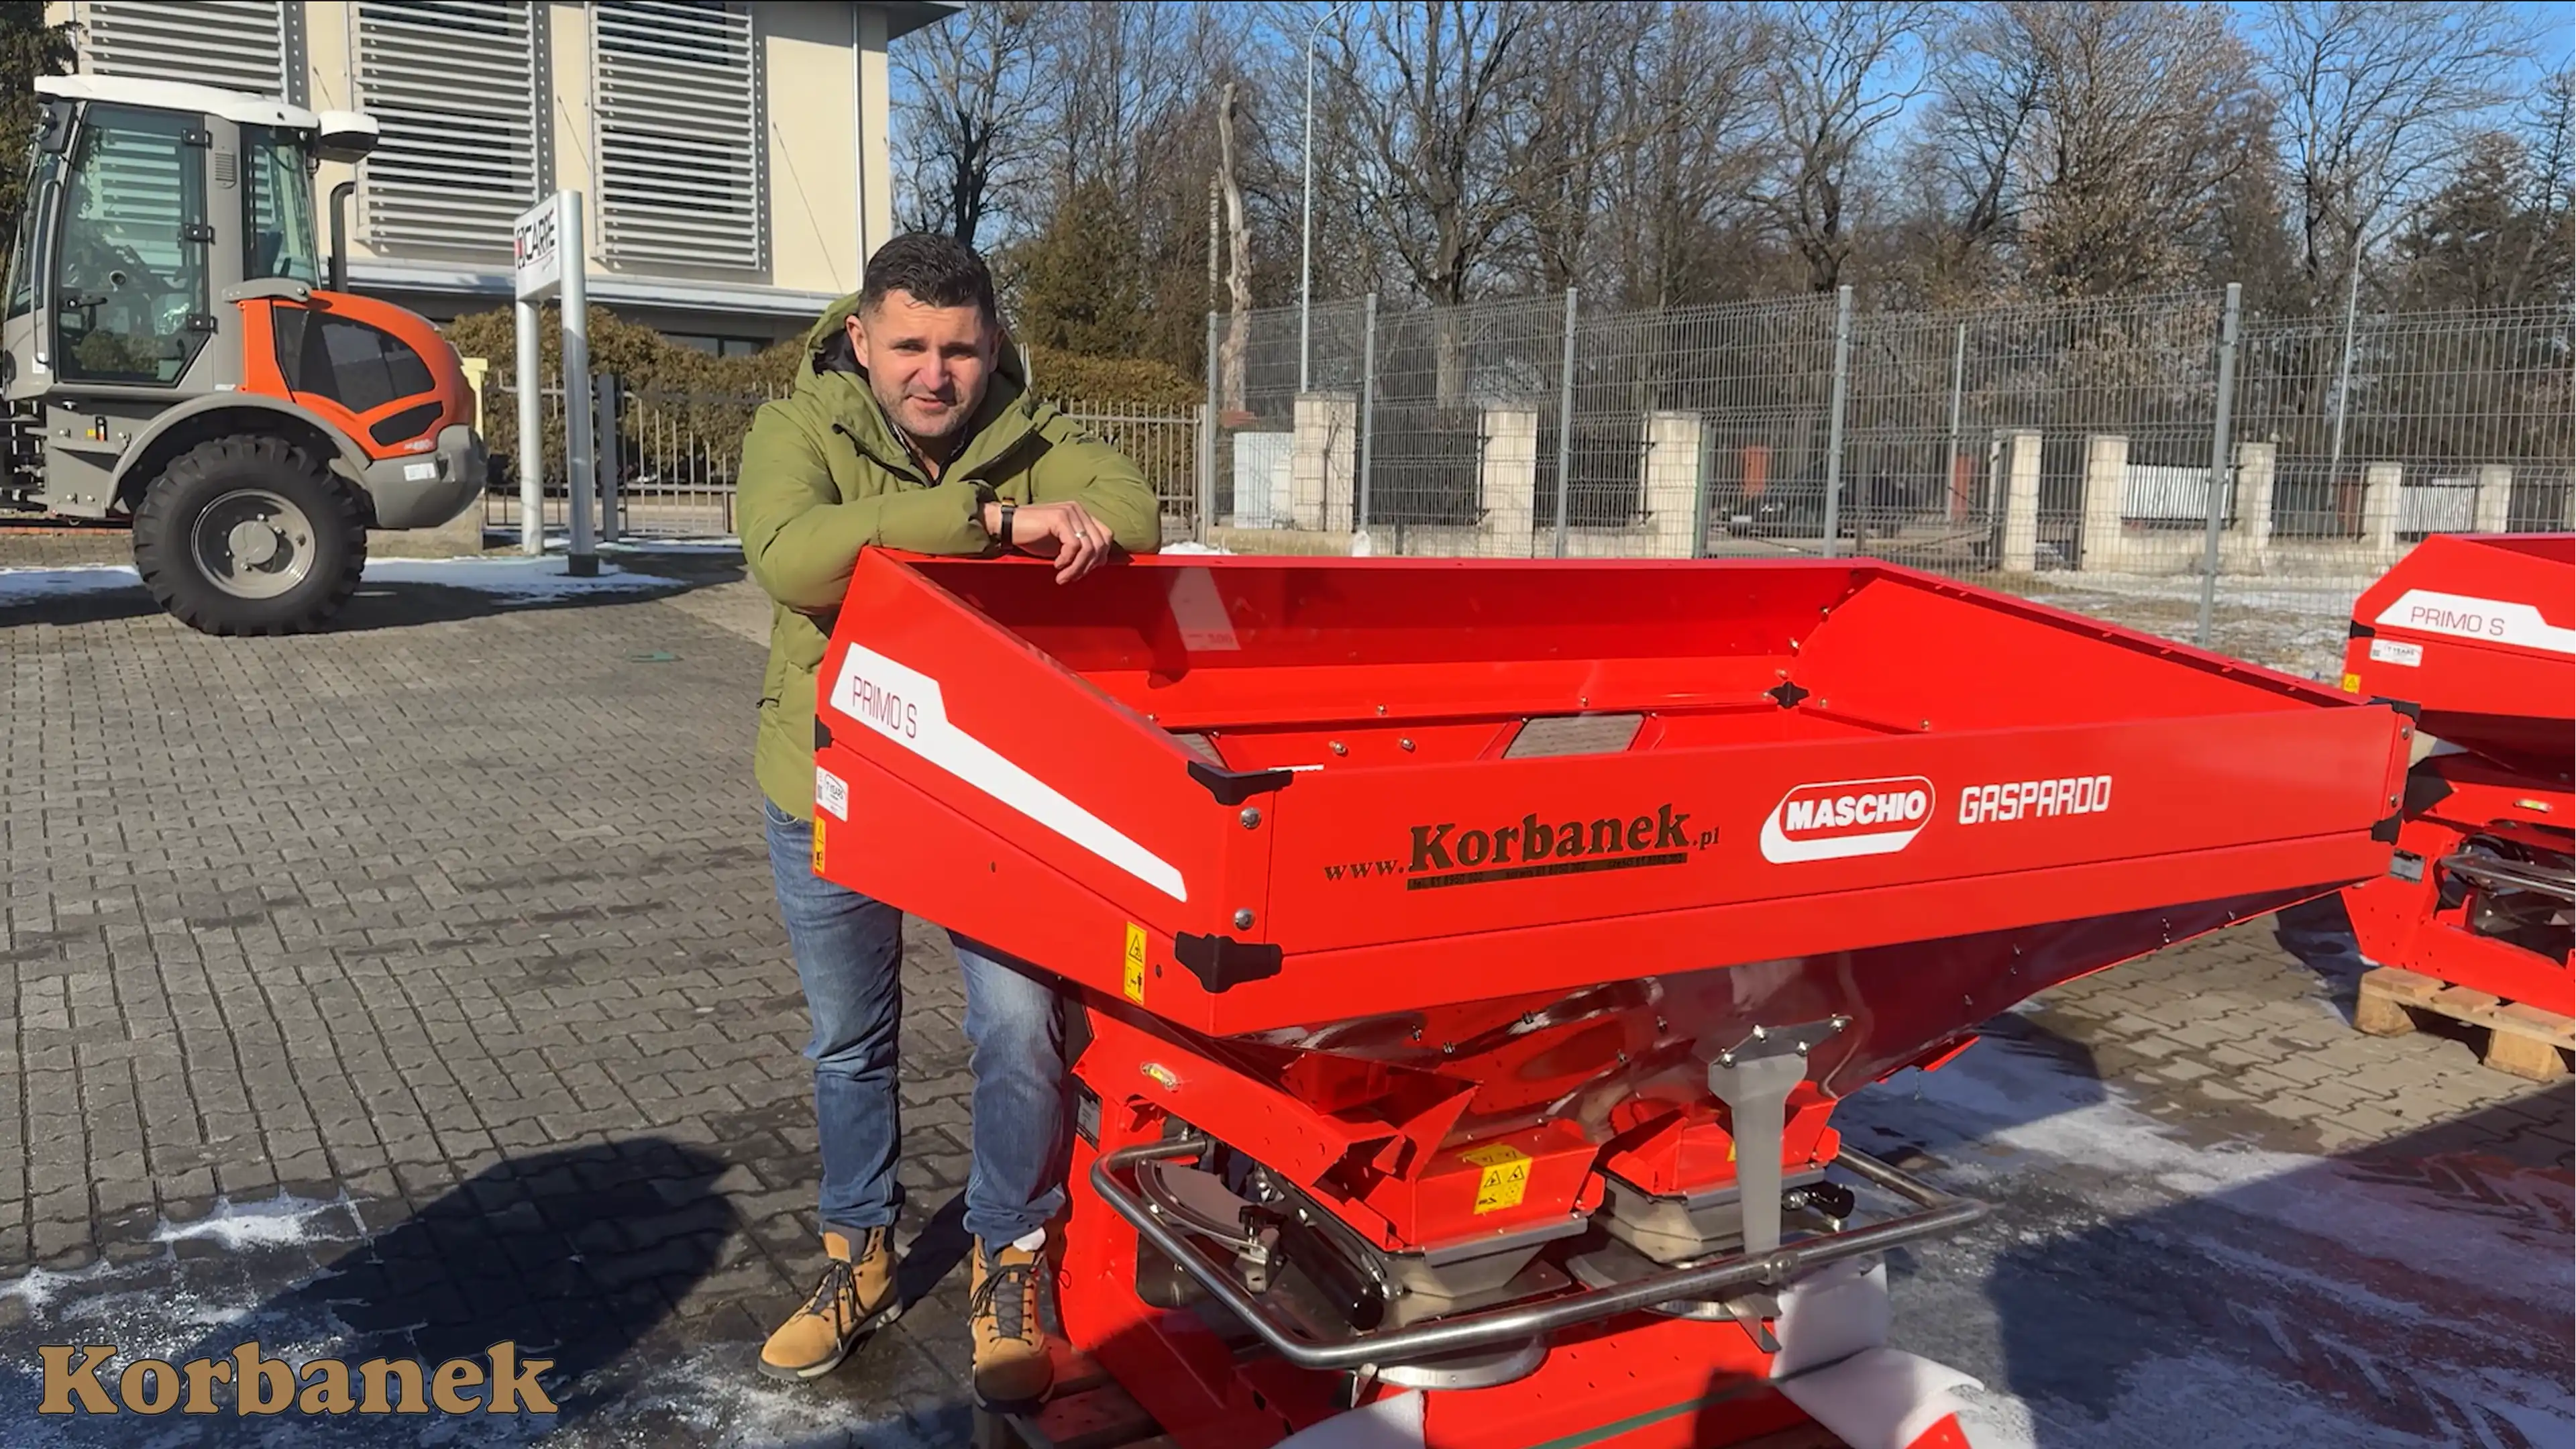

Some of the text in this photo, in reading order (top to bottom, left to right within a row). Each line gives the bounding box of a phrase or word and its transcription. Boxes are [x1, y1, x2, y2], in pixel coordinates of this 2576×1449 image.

[2410, 606, 2505, 636] PRIMO S
[853, 675, 918, 739] PRIMO S
[1786, 774, 2113, 832] MASCHIO GASPARDO
